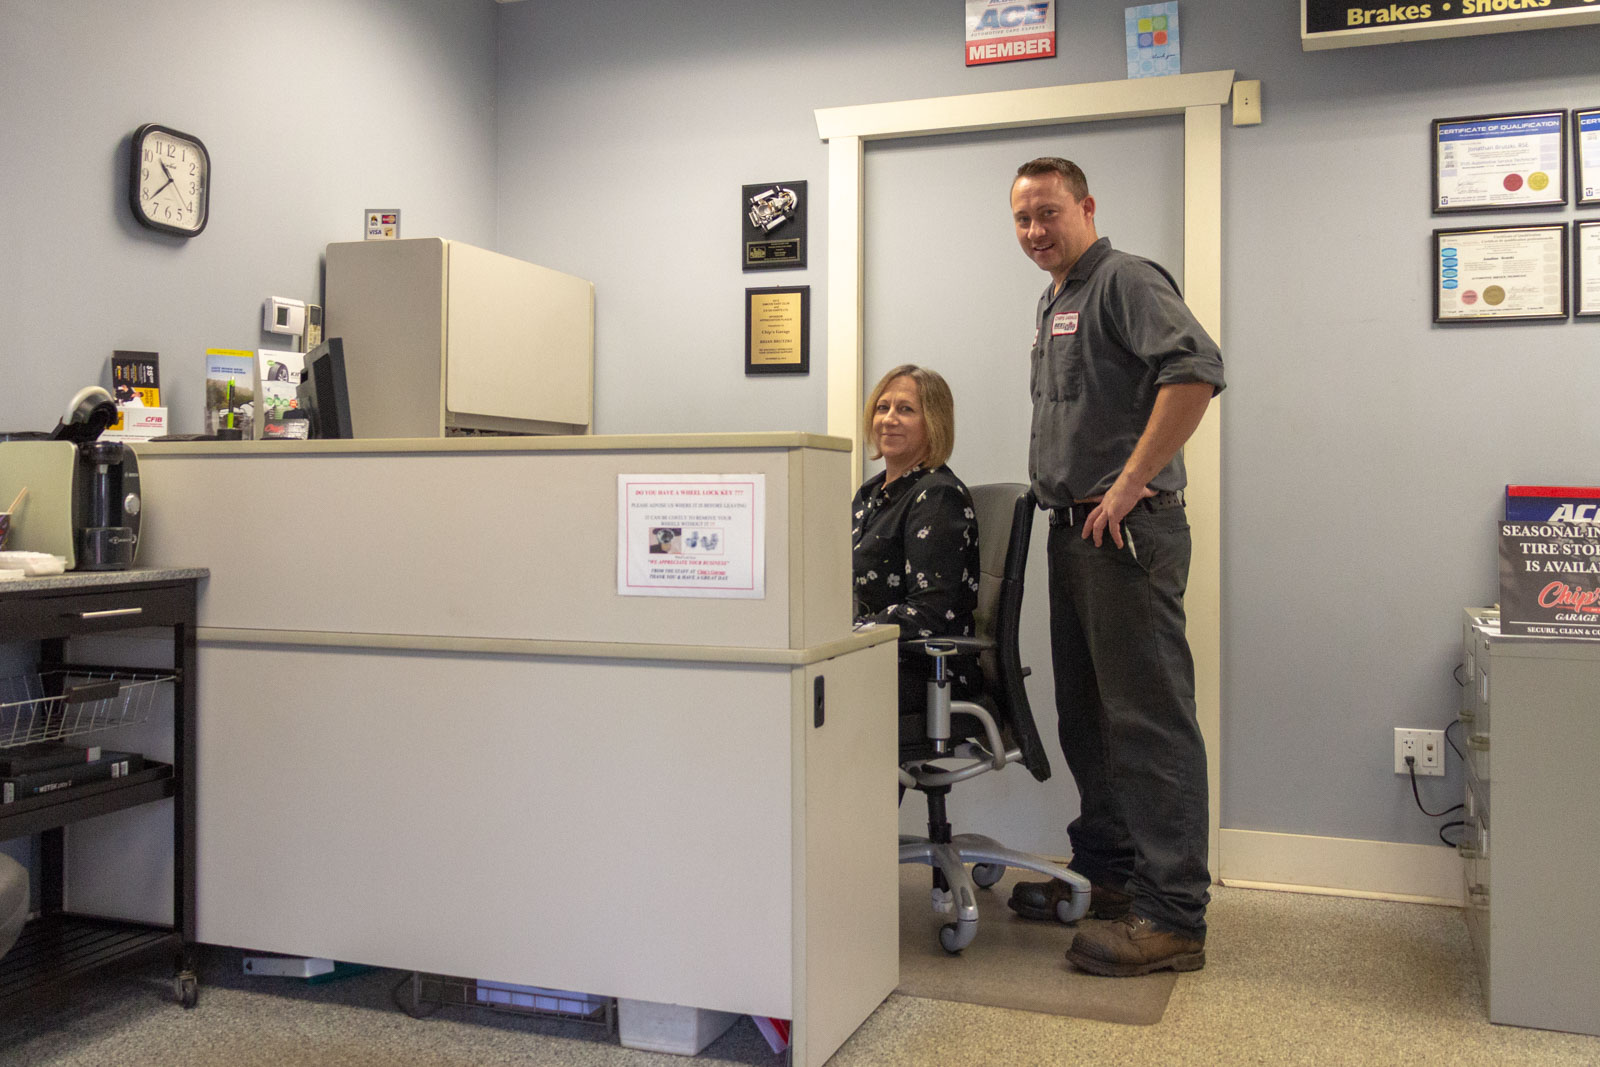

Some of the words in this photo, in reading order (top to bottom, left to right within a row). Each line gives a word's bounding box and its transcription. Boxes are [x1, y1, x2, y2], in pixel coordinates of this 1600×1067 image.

[975, 3, 1049, 31] ACE
[1347, 2, 1432, 26] Brakes
[969, 38, 1051, 61] MEMBER
[1439, 126, 1486, 135] CERTIFICATE
[1500, 120, 1560, 131] QUALIFICATION
[156, 141, 162, 155] 11
[167, 144, 176, 158] 12
[144, 148, 153, 163] 10
[181, 149, 186, 162] 1
[142, 168, 149, 181] 9
[189, 163, 196, 176] 2
[142, 187, 149, 200] 8
[189, 181, 196, 195] 3
[153, 202, 159, 215] 7
[164, 206, 171, 219] 6
[186, 201, 193, 214] 4
[176, 208, 183, 221] 5
[1502, 525, 1584, 538] SEASONAL
[1520, 543, 1559, 555] TIRE
[1525, 560, 1540, 572] IS
[1543, 561, 1600, 573] AVAILA
[1555, 613, 1599, 622] GARAGE
[1527, 626, 1558, 635] SECURE,
